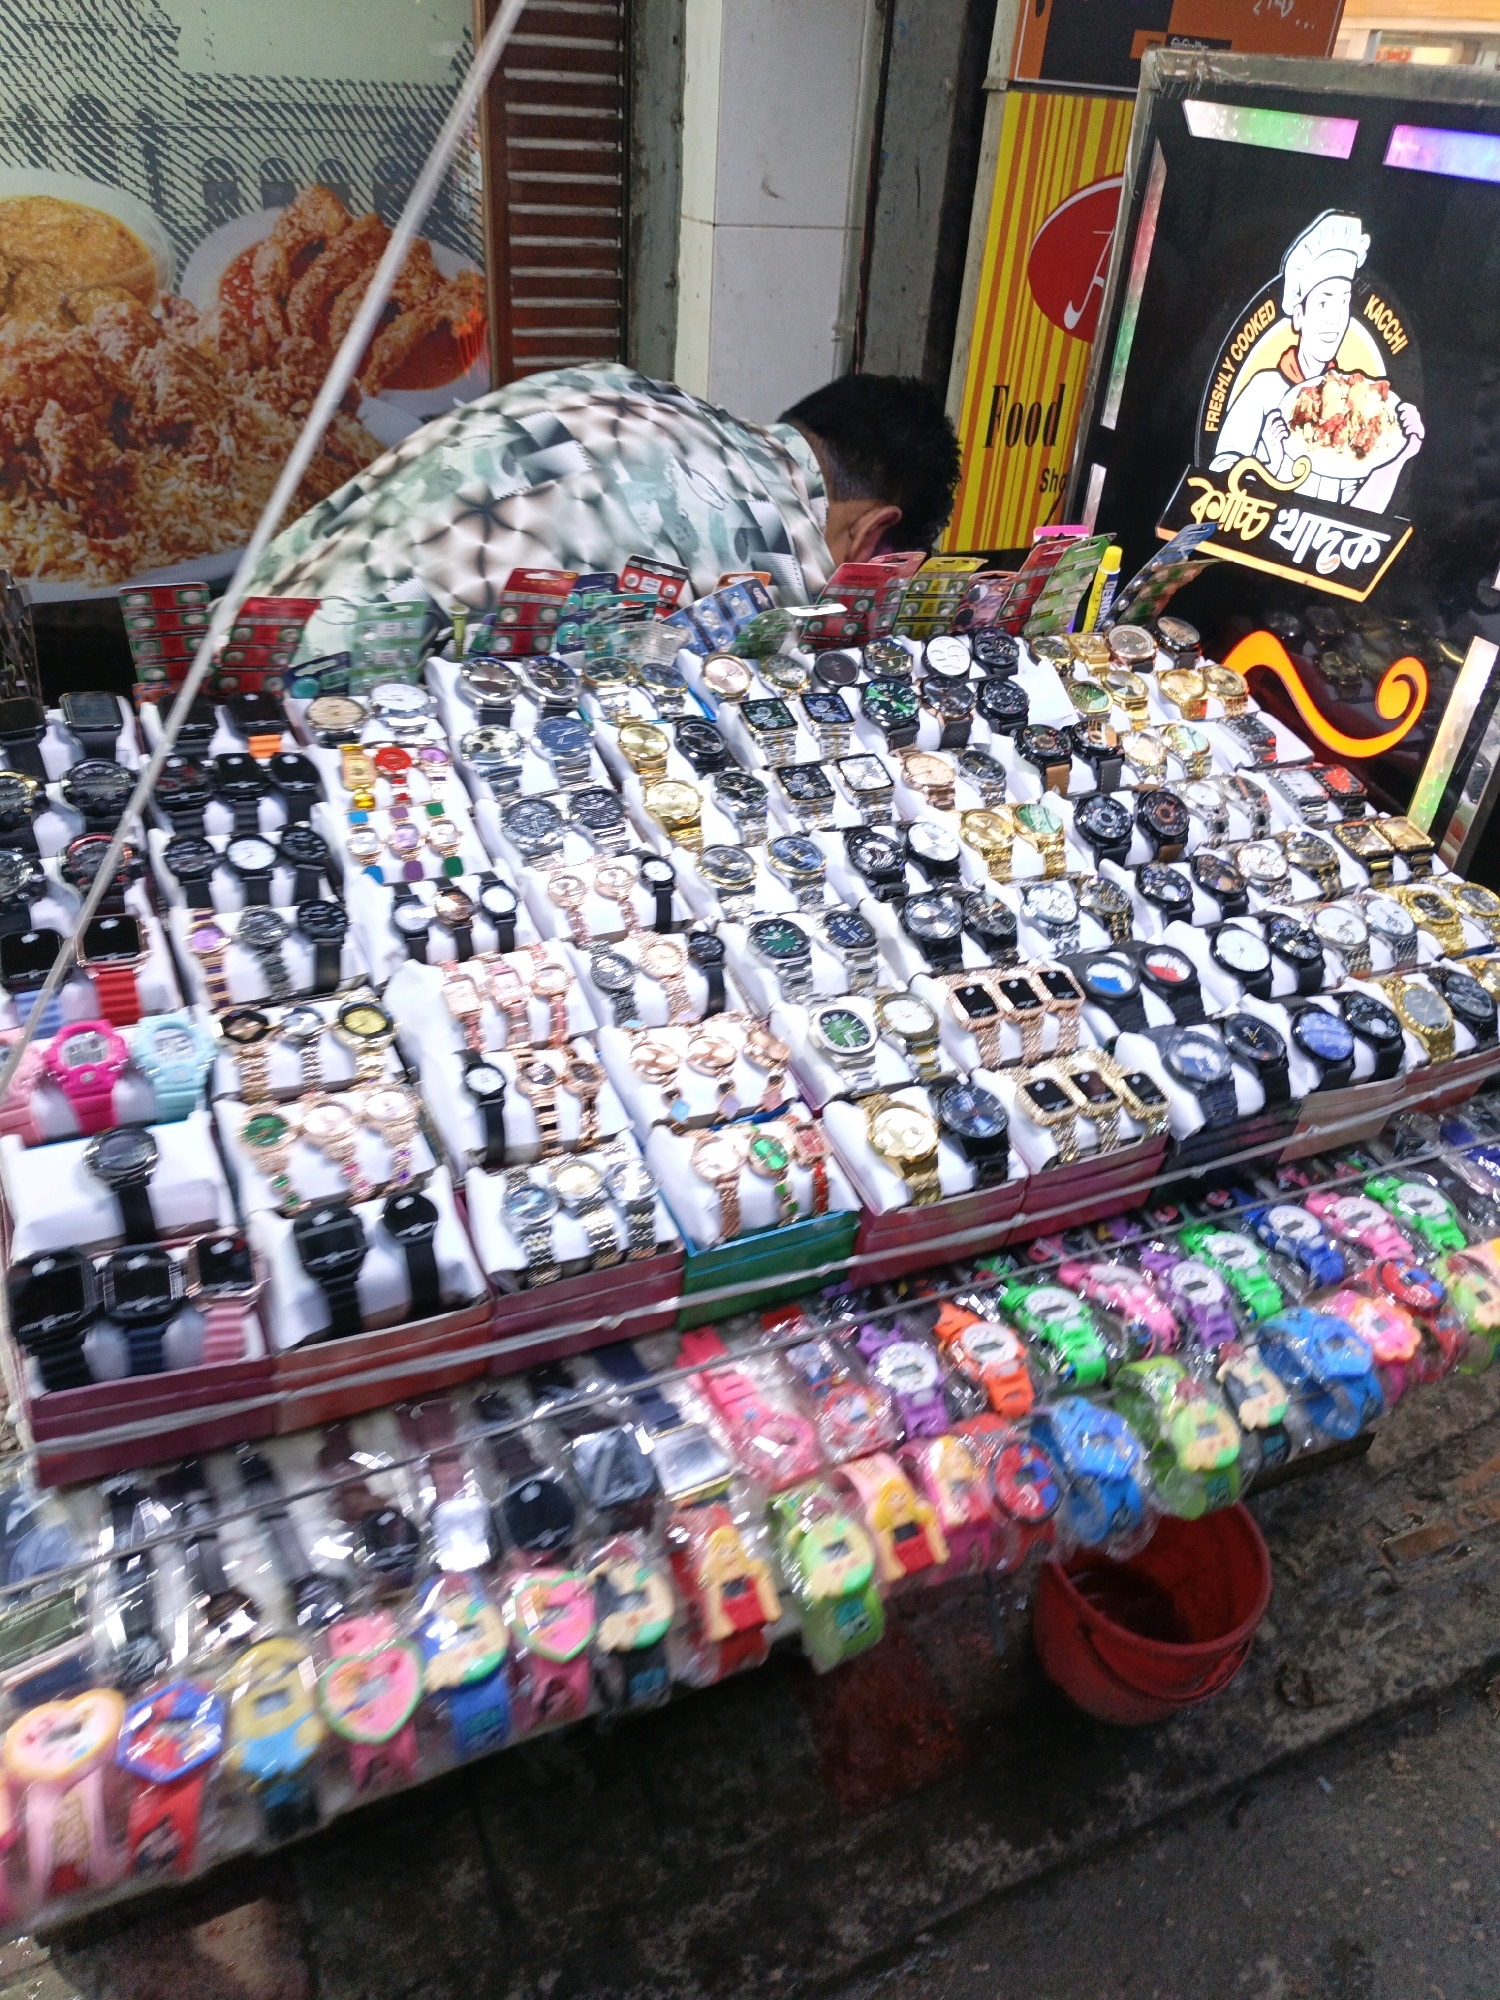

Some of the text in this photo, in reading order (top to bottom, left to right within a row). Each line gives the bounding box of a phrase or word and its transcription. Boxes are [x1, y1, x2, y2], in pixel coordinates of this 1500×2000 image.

[1363, 294, 1409, 355] KACCHI
[1204, 299, 1276, 432] FRESHLY COOKED
[983, 383, 1066, 449] Food
[1269, 507, 1391, 575] খাদক
